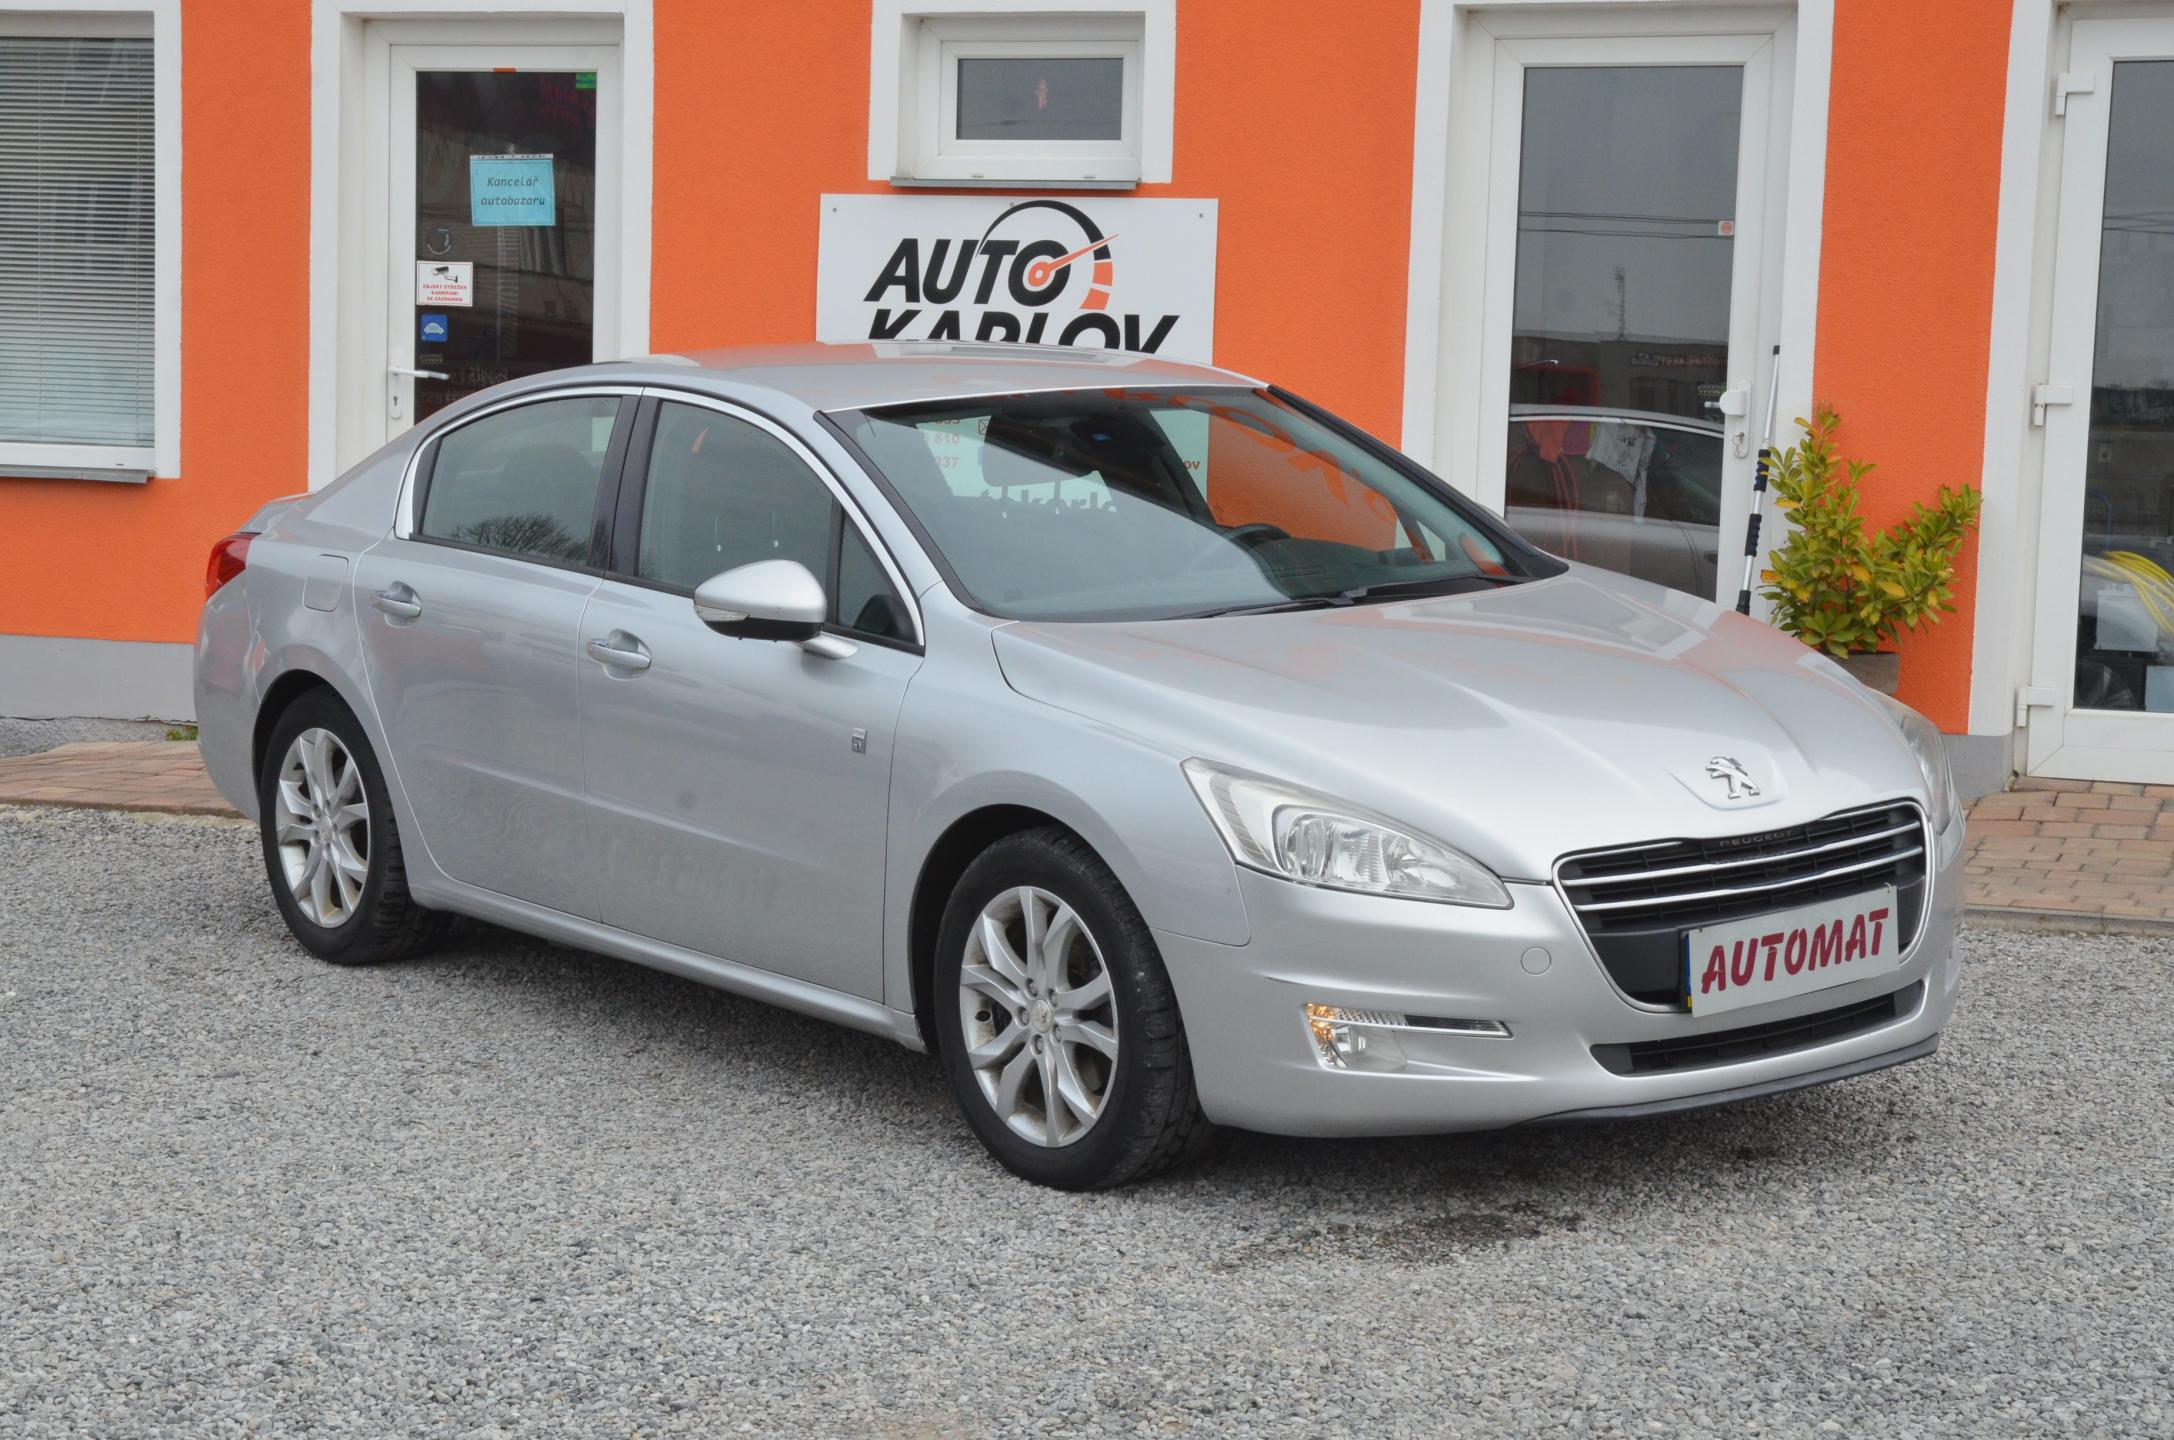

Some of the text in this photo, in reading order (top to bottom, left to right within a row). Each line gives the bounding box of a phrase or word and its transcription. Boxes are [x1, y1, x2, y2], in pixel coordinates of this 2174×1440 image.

[480, 195, 546, 206] autobazaru
[487, 175, 540, 187] Kancelář
[863, 238, 1072, 307] AUTO
[1701, 907, 1889, 994] AUTOMAT
